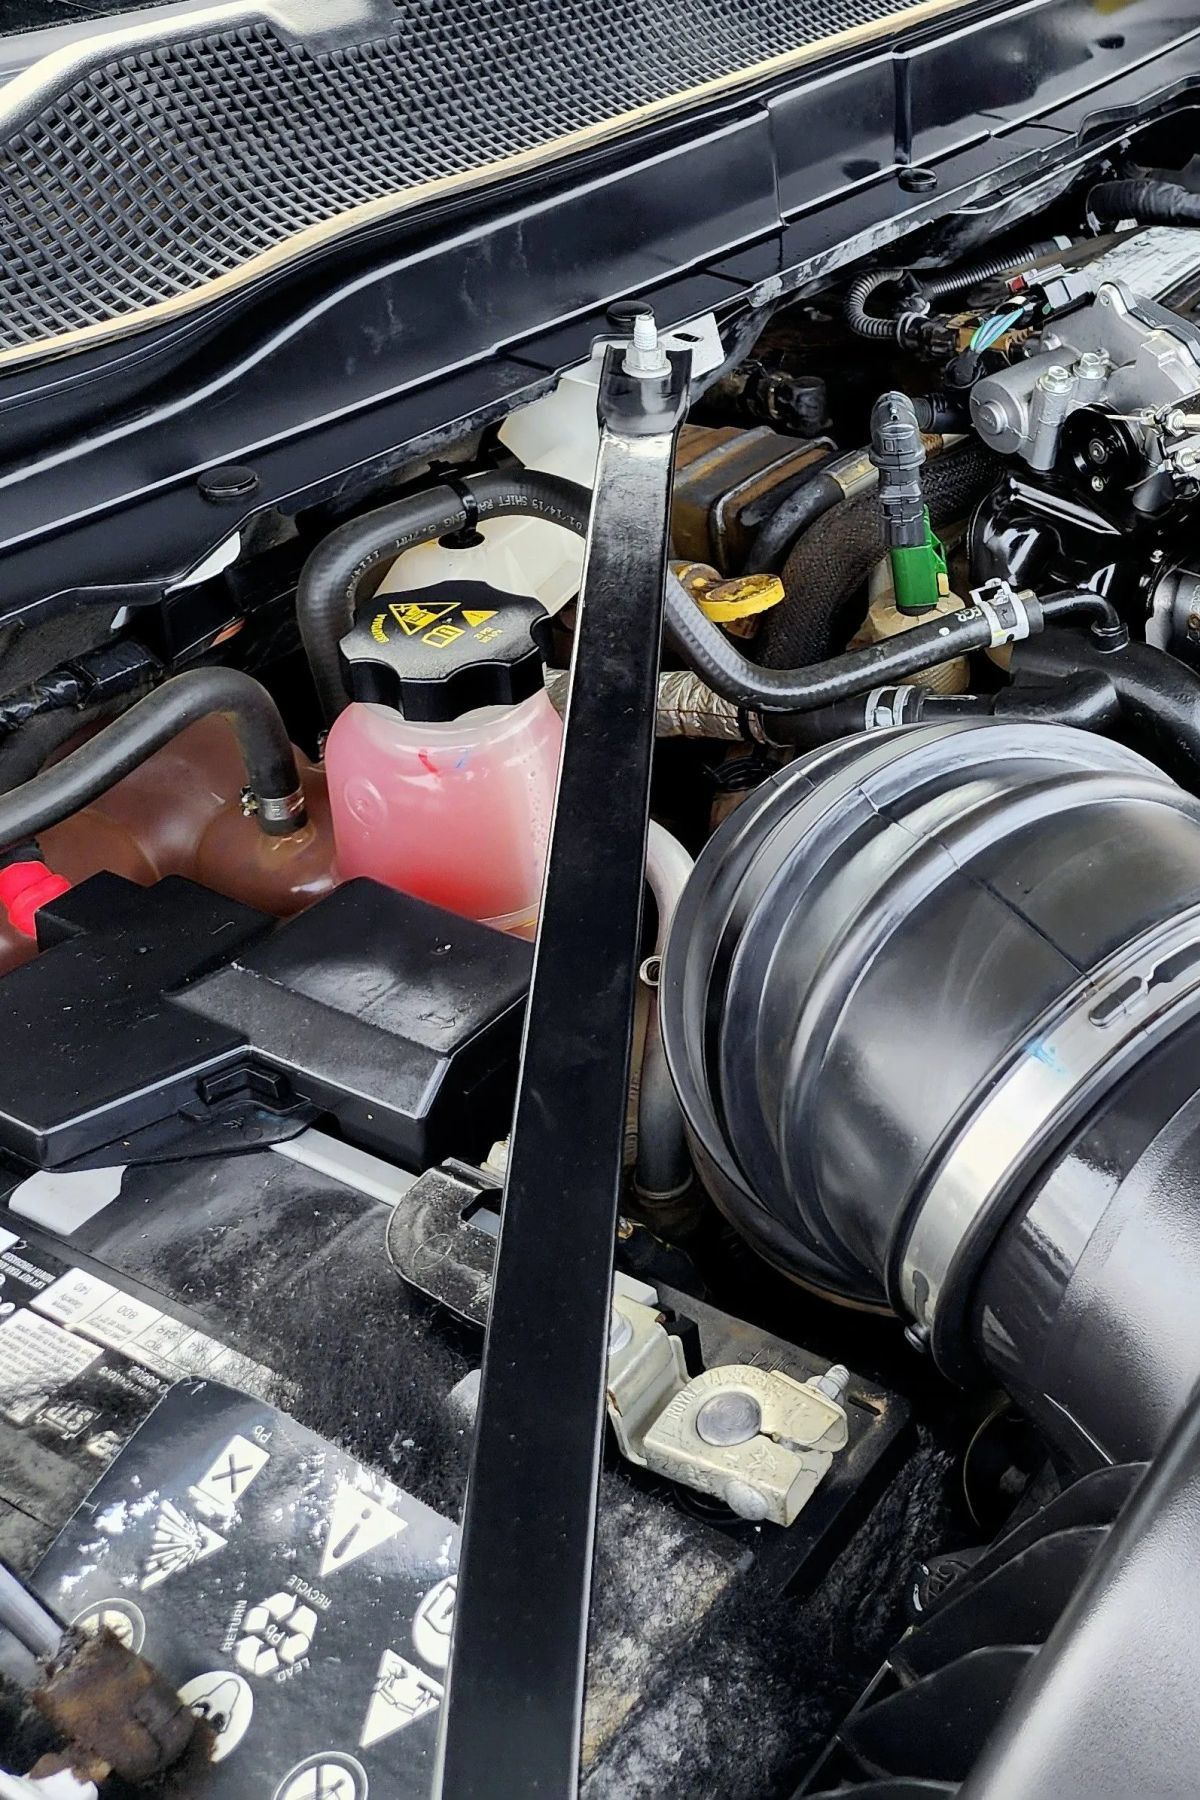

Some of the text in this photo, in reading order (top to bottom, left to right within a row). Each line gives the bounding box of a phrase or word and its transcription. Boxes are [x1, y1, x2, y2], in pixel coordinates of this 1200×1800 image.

[499, 495, 528, 507] SHIFT
[254, 1425, 272, 1443] Pb
[287, 1574, 332, 1609] RECYCLE
[223, 1600, 247, 1651] RETURN
[265, 1624, 286, 1645] Pb
[277, 1657, 310, 1682] LEAD
